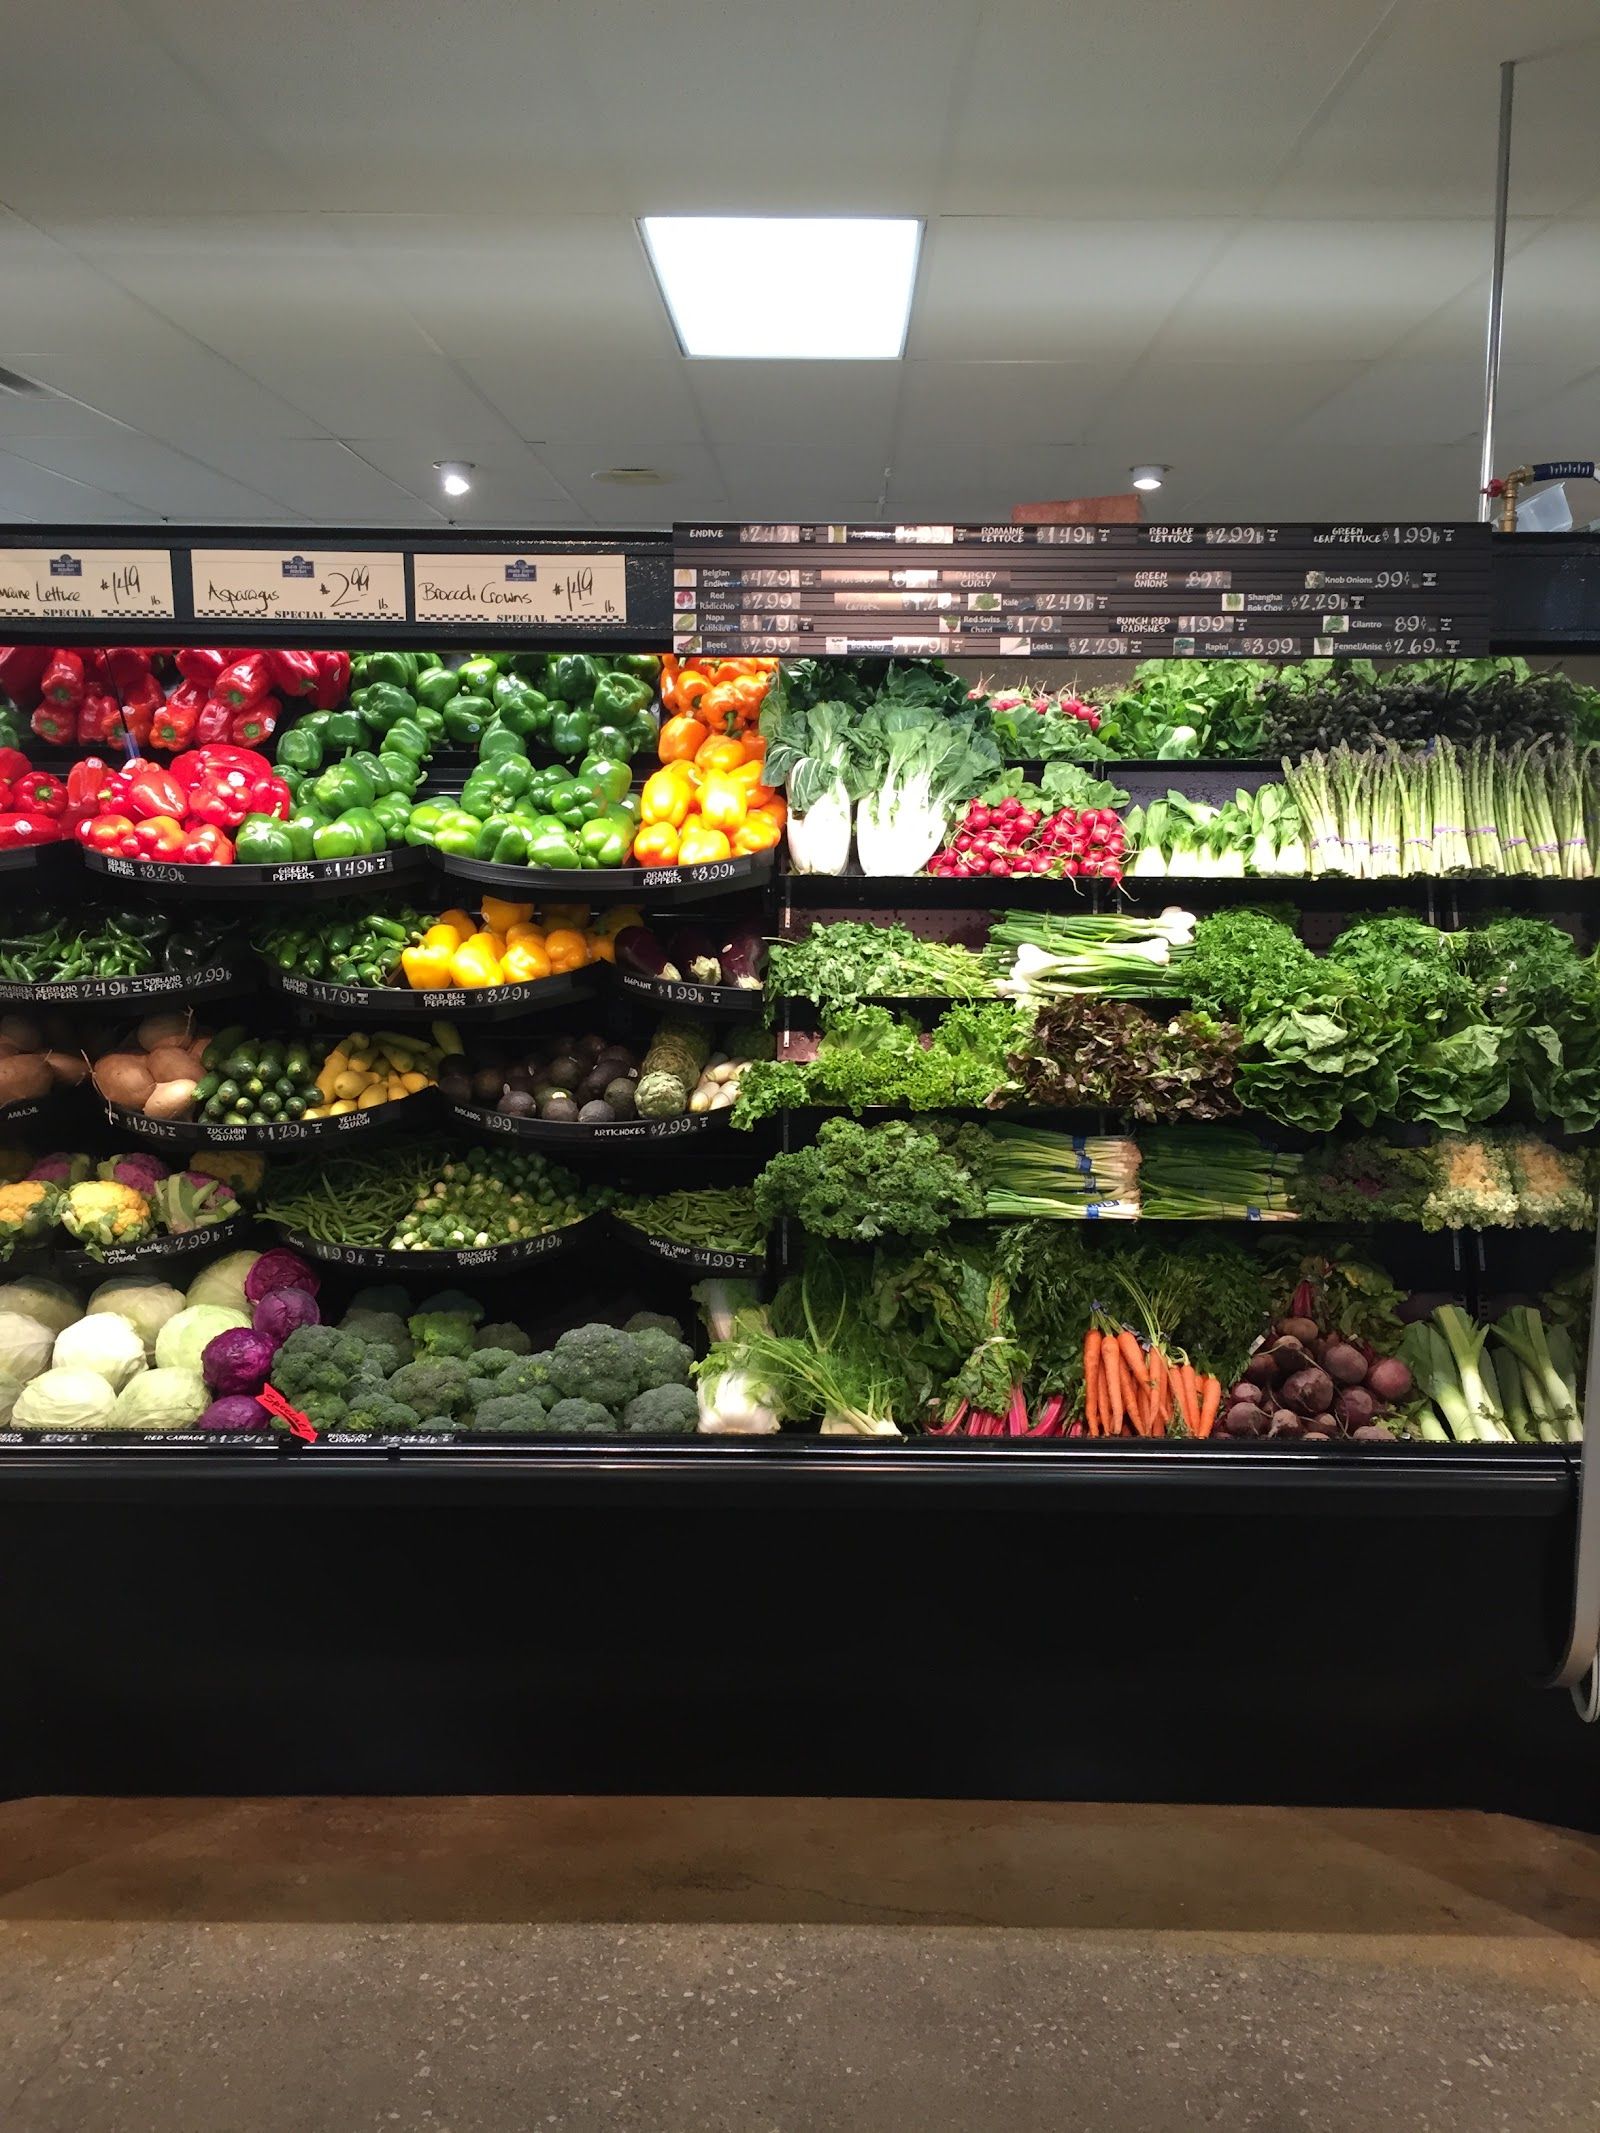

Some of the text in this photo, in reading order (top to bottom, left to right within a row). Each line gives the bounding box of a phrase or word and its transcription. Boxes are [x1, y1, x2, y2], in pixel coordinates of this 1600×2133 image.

[690, 529, 724, 538] ENDIVE
[981, 527, 1025, 535] ROMAINE
[1149, 527, 1194, 535] RED LEAF
[1332, 527, 1363, 535] GREEN
[981, 534, 1025, 543] LETTUCE
[1150, 535, 1194, 543] LETTUCE
[1314, 535, 1382, 543] LEAF LETTUCE
[703, 570, 730, 579] Belgian
[1135, 571, 1167, 579] GREEN
[960, 579, 992, 588] CURLY
[1134, 580, 1168, 588] ONIONS
[1346, 576, 1373, 584] Onions
[36, 581, 80, 602] Lettuce
[208, 579, 280, 611] Asparagus
[481, 582, 532, 604] Crowns
[1003, 598, 1019, 606] Kale
[1248, 594, 1282, 603] Shanghai
[699, 601, 735, 610] Radicchio
[43, 608, 95, 617] SPECIAL
[274, 611, 327, 619] SPECIAL
[497, 614, 547, 622] SPECIAL
[706, 614, 725, 622] Napa
[1116, 616, 1170, 625] BUNCH RED
[970, 625, 993, 633] Chard
[1121, 625, 1166, 633] RADISHES
[707, 641, 727, 649] Beets
[1205, 643, 1229, 651] Rapini
[1334, 642, 1382, 651] Fennel/Anise
[107, 858, 133, 869] RED BELL
[108, 864, 136, 877] PEPPERS
[278, 865, 308, 875] GREEN
[646, 869, 679, 879] ORANGE
[273, 871, 315, 882] PEPPERS
[643, 876, 682, 886] PEPPERS
[143, 975, 181, 986] POBLANO
[624, 976, 652, 990] EGGPLANT
[35, 984, 77, 993] SERRANO
[283, 982, 308, 996] PEPPERS
[36, 991, 79, 1000] PEPPERS
[425, 999, 466, 1007] PEPPERS
[339, 1112, 368, 1124] YELLOW
[338, 1118, 370, 1130] SQUASH
[207, 1127, 247, 1135] ZUCCHINI
[594, 1127, 646, 1137] ARTICHOKES
[212, 1133, 245, 1141] SQUASH
[649, 1238, 691, 1255] SUGAR SNAP
[456, 1248, 498, 1259] BRUSSELS
[660, 1248, 678, 1258] PEAS
[458, 1256, 497, 1266] SPROUTS
